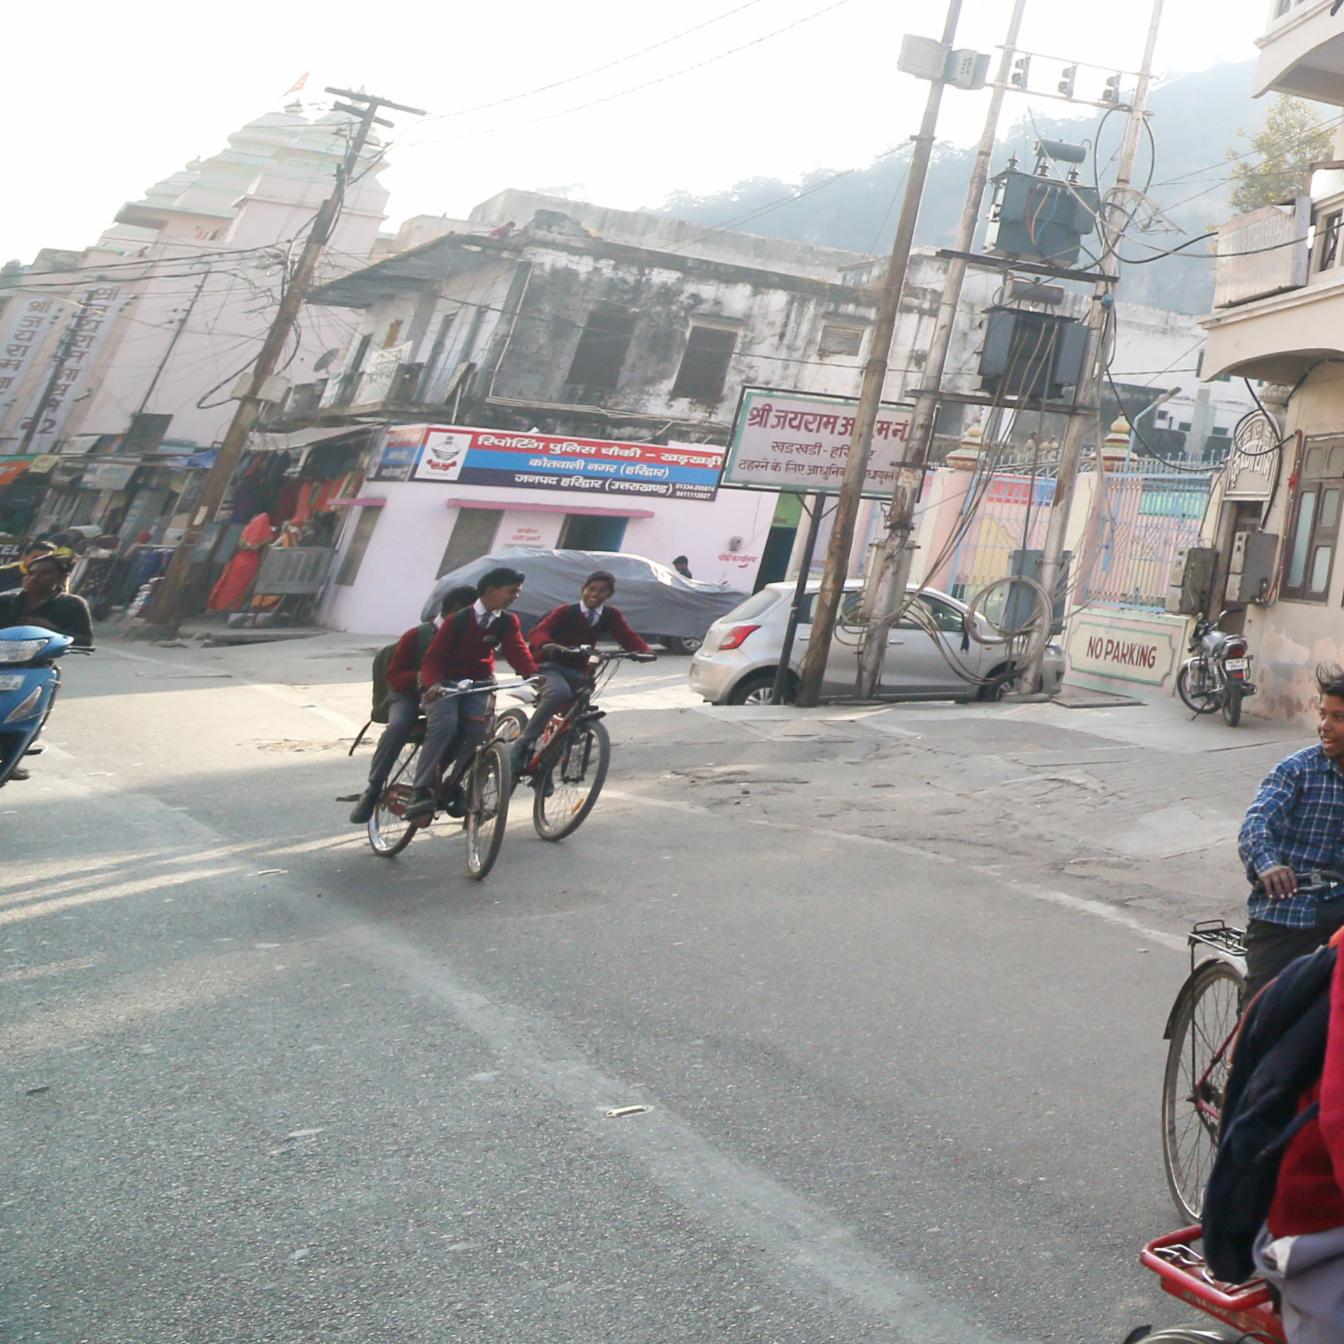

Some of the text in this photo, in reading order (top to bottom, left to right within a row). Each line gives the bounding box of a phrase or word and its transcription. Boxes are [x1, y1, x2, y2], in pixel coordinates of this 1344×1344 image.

[747, 403, 773, 429] श्री
[771, 409, 840, 435] जयराम
[550, 442, 597, 455] पुलिस
[601, 445, 642, 458] चौकी
[528, 457, 585, 471] कोतवाली
[587, 463, 616, 473] नगर
[514, 473, 559, 485] जनपद
[1086, 635, 1157, 669] NO PARKING
